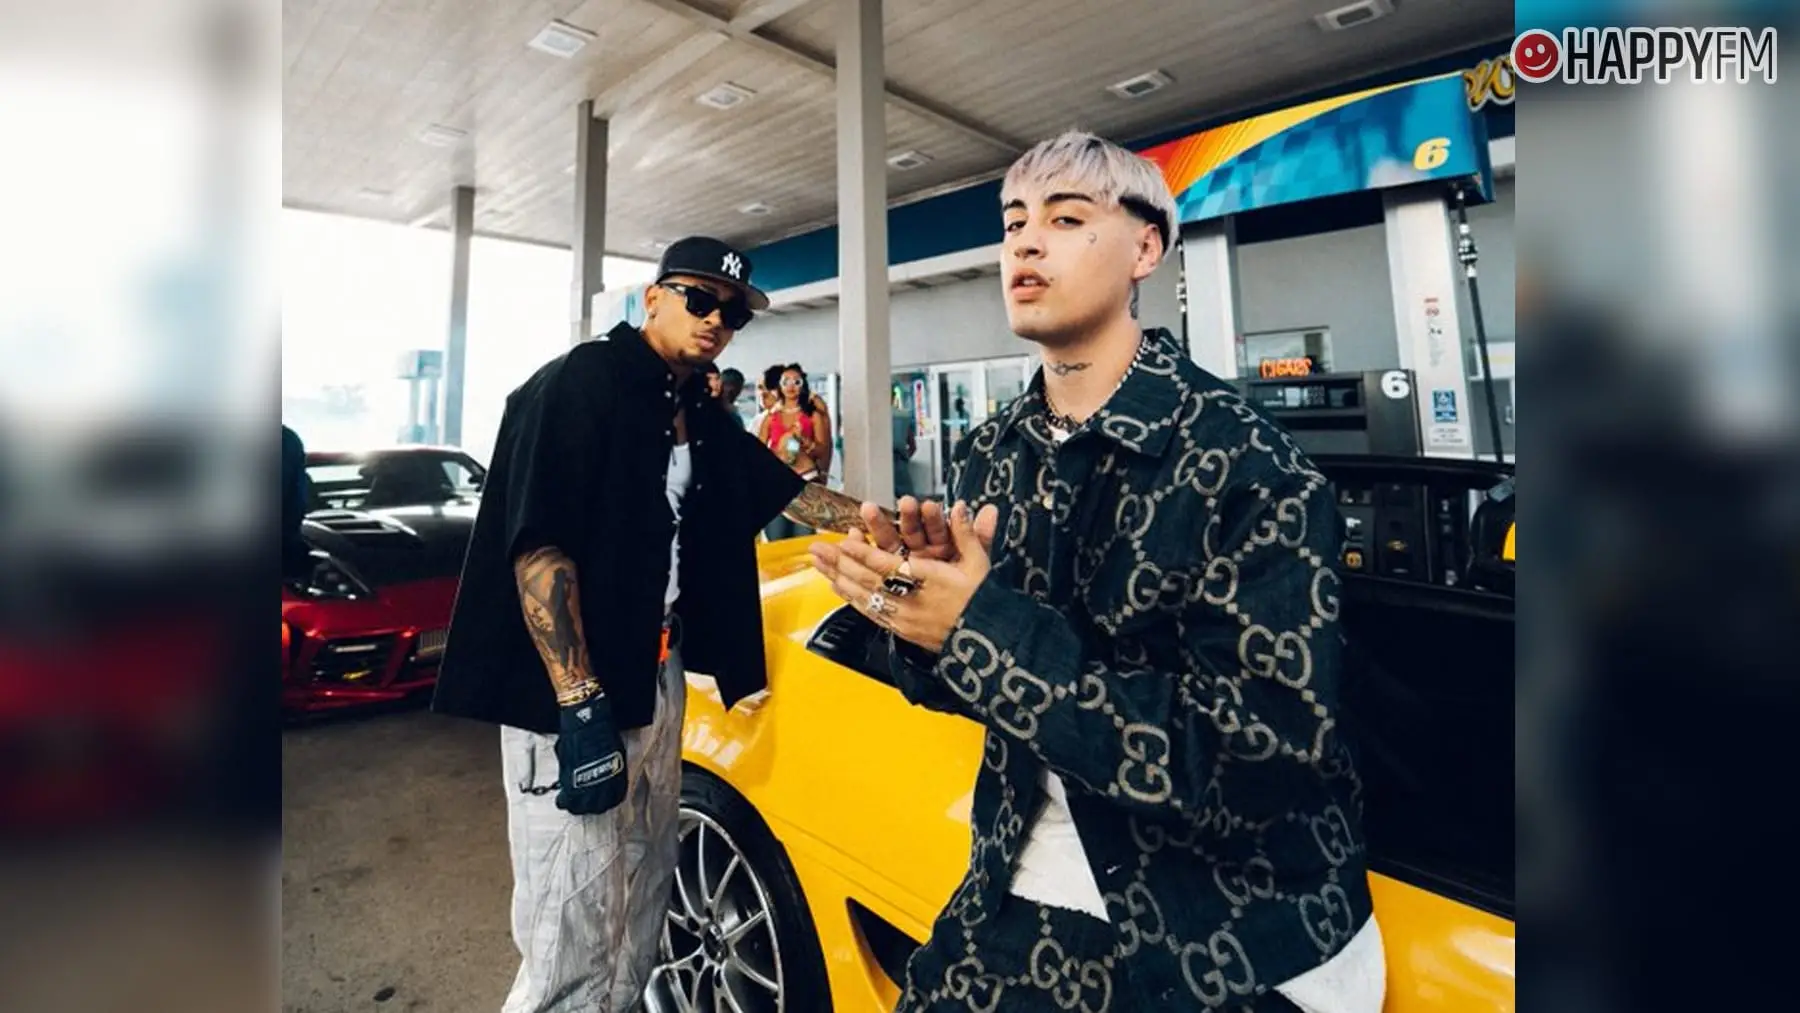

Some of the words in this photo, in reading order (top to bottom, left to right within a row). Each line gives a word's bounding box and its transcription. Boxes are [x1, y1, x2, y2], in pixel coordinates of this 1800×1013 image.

[1414, 137, 1451, 170] 6
[721, 252, 743, 279] NY
[1261, 357, 1312, 378] CIGARS
[1381, 370, 1410, 399] 6
